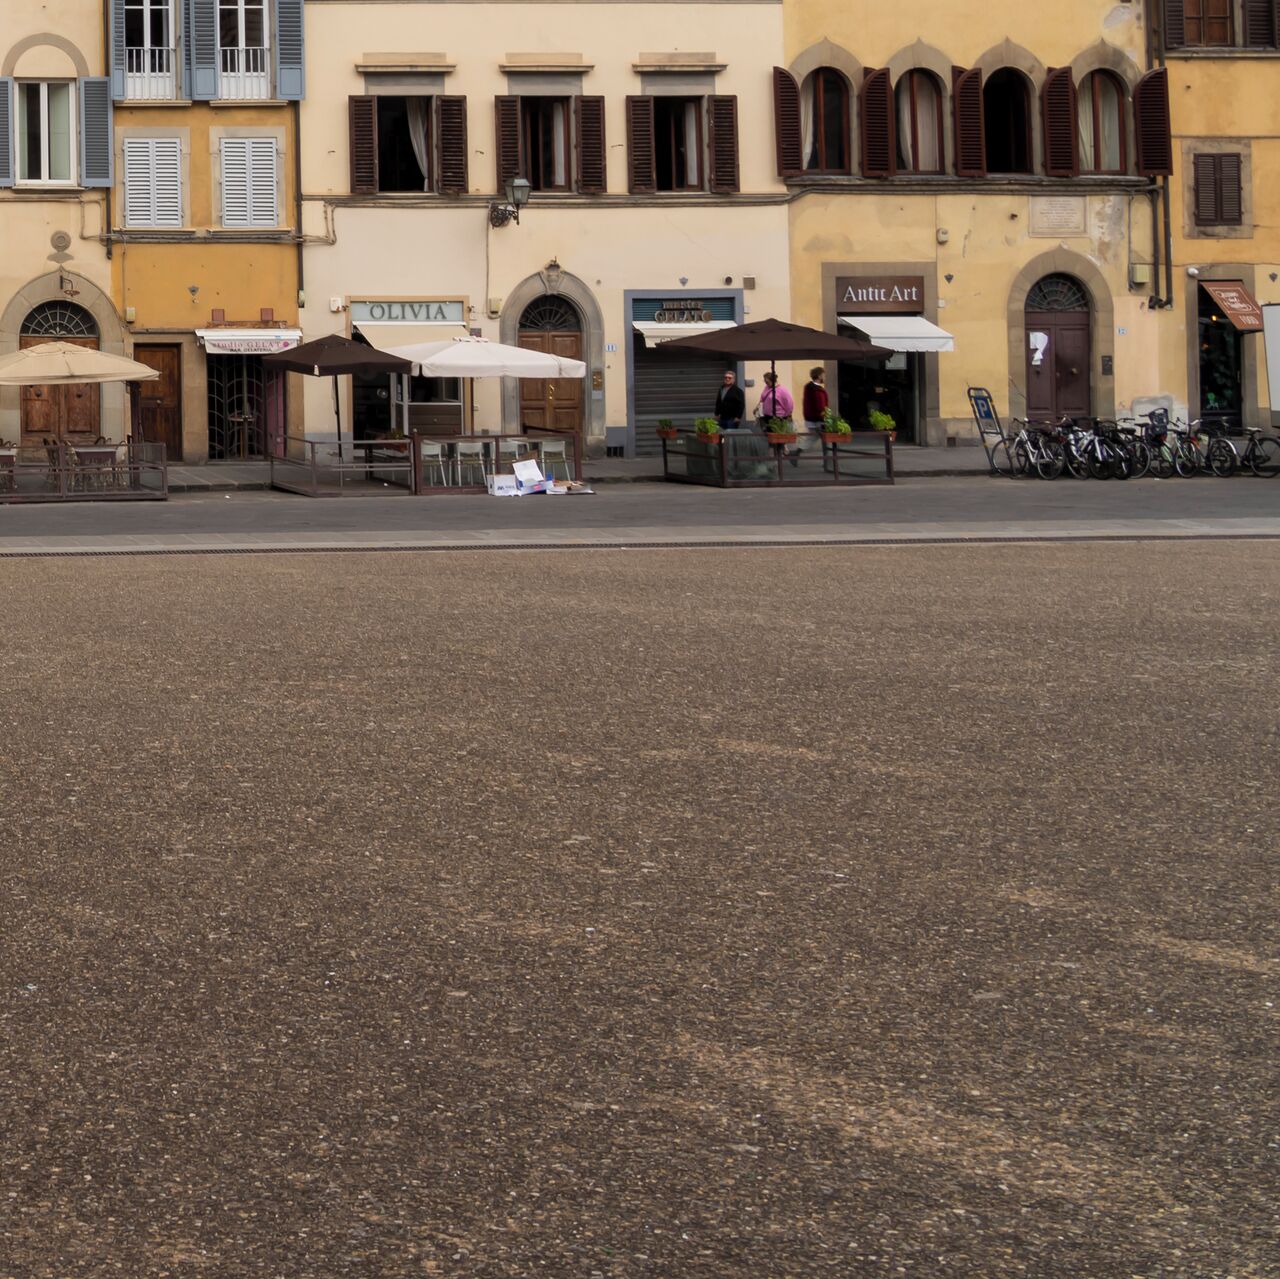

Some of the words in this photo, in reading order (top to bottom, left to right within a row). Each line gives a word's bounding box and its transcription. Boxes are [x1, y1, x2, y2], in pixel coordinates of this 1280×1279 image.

[843, 285, 886, 302] Antic
[889, 284, 918, 302] Art
[369, 303, 447, 320] OLIVIA
[976, 399, 988, 417] P
